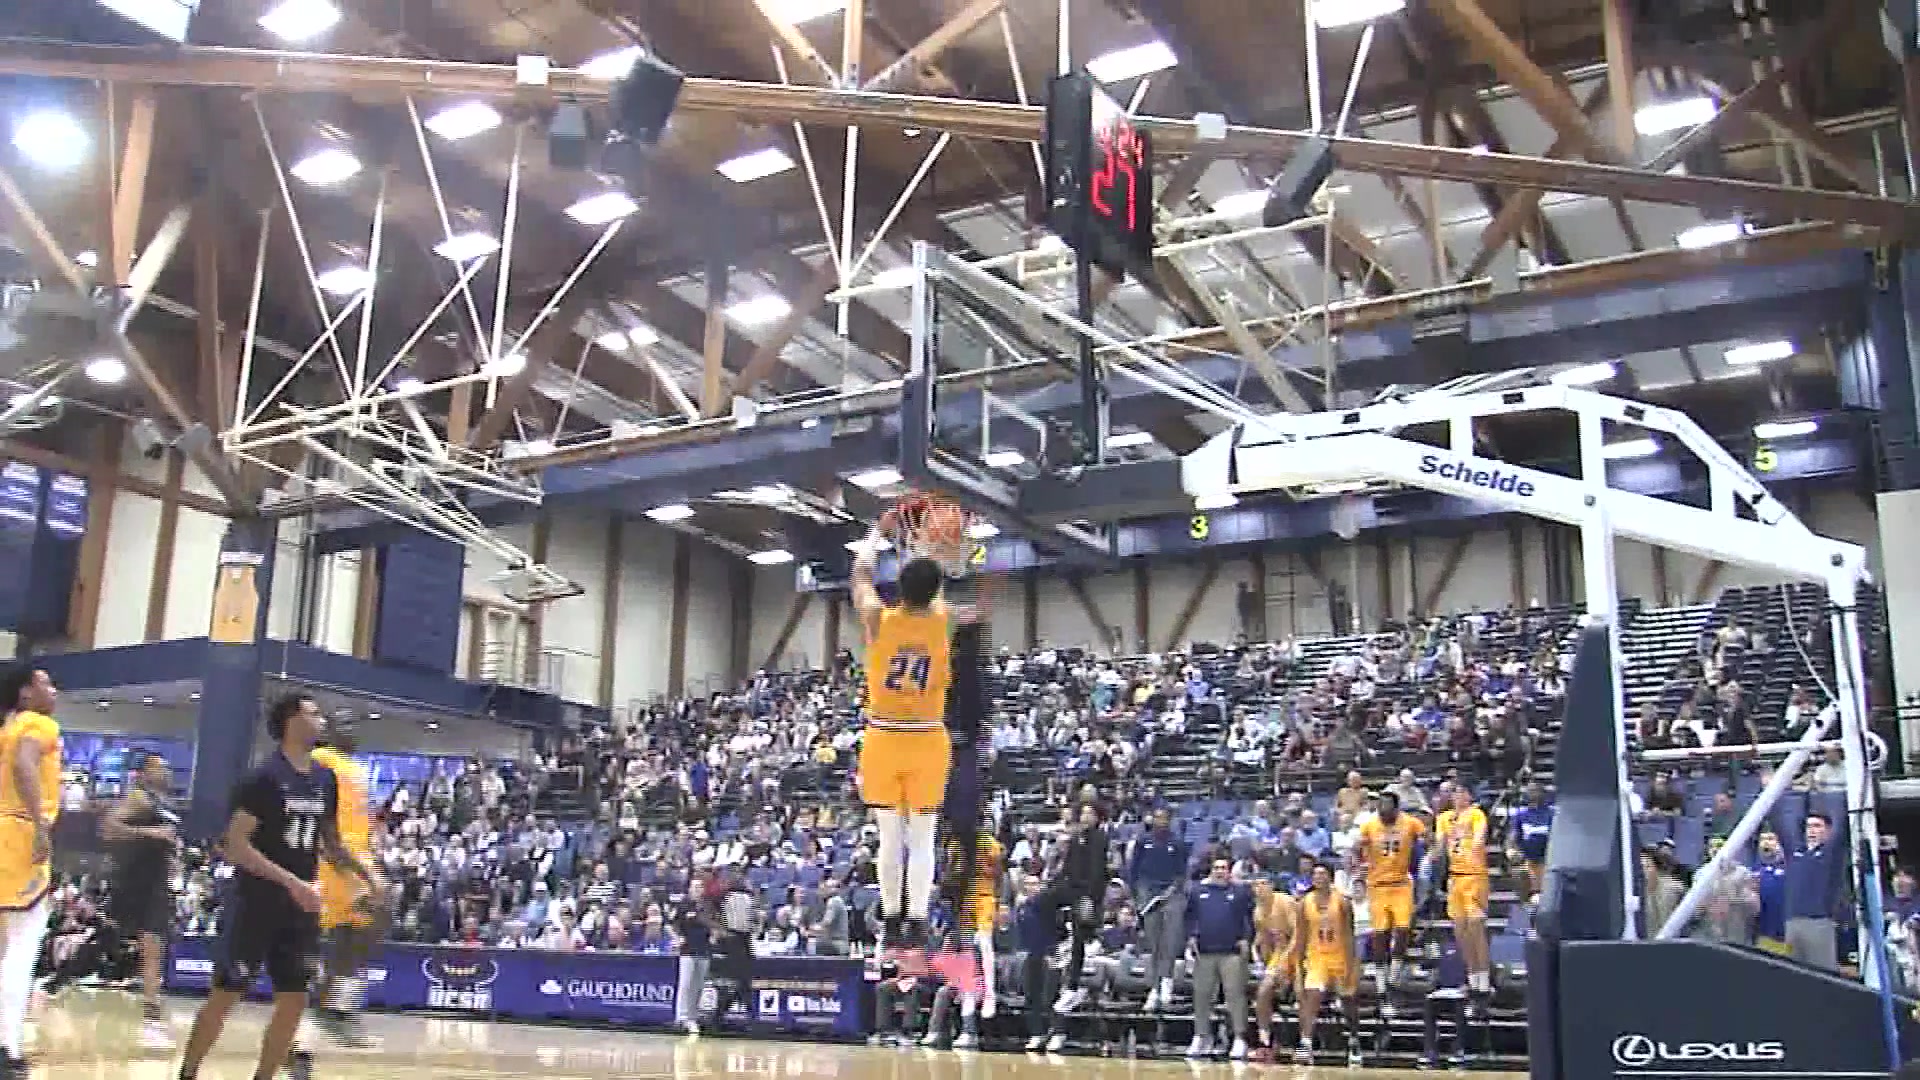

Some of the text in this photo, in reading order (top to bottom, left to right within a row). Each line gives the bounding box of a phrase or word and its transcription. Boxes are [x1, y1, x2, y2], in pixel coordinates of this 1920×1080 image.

[1753, 446, 1778, 472] 5
[1419, 454, 1536, 497] Schelde
[1189, 515, 1209, 539] 3
[883, 654, 931, 692] 24
[566, 980, 674, 1002] GAUCHOFUND
[1658, 1041, 1785, 1060] LEXUS
